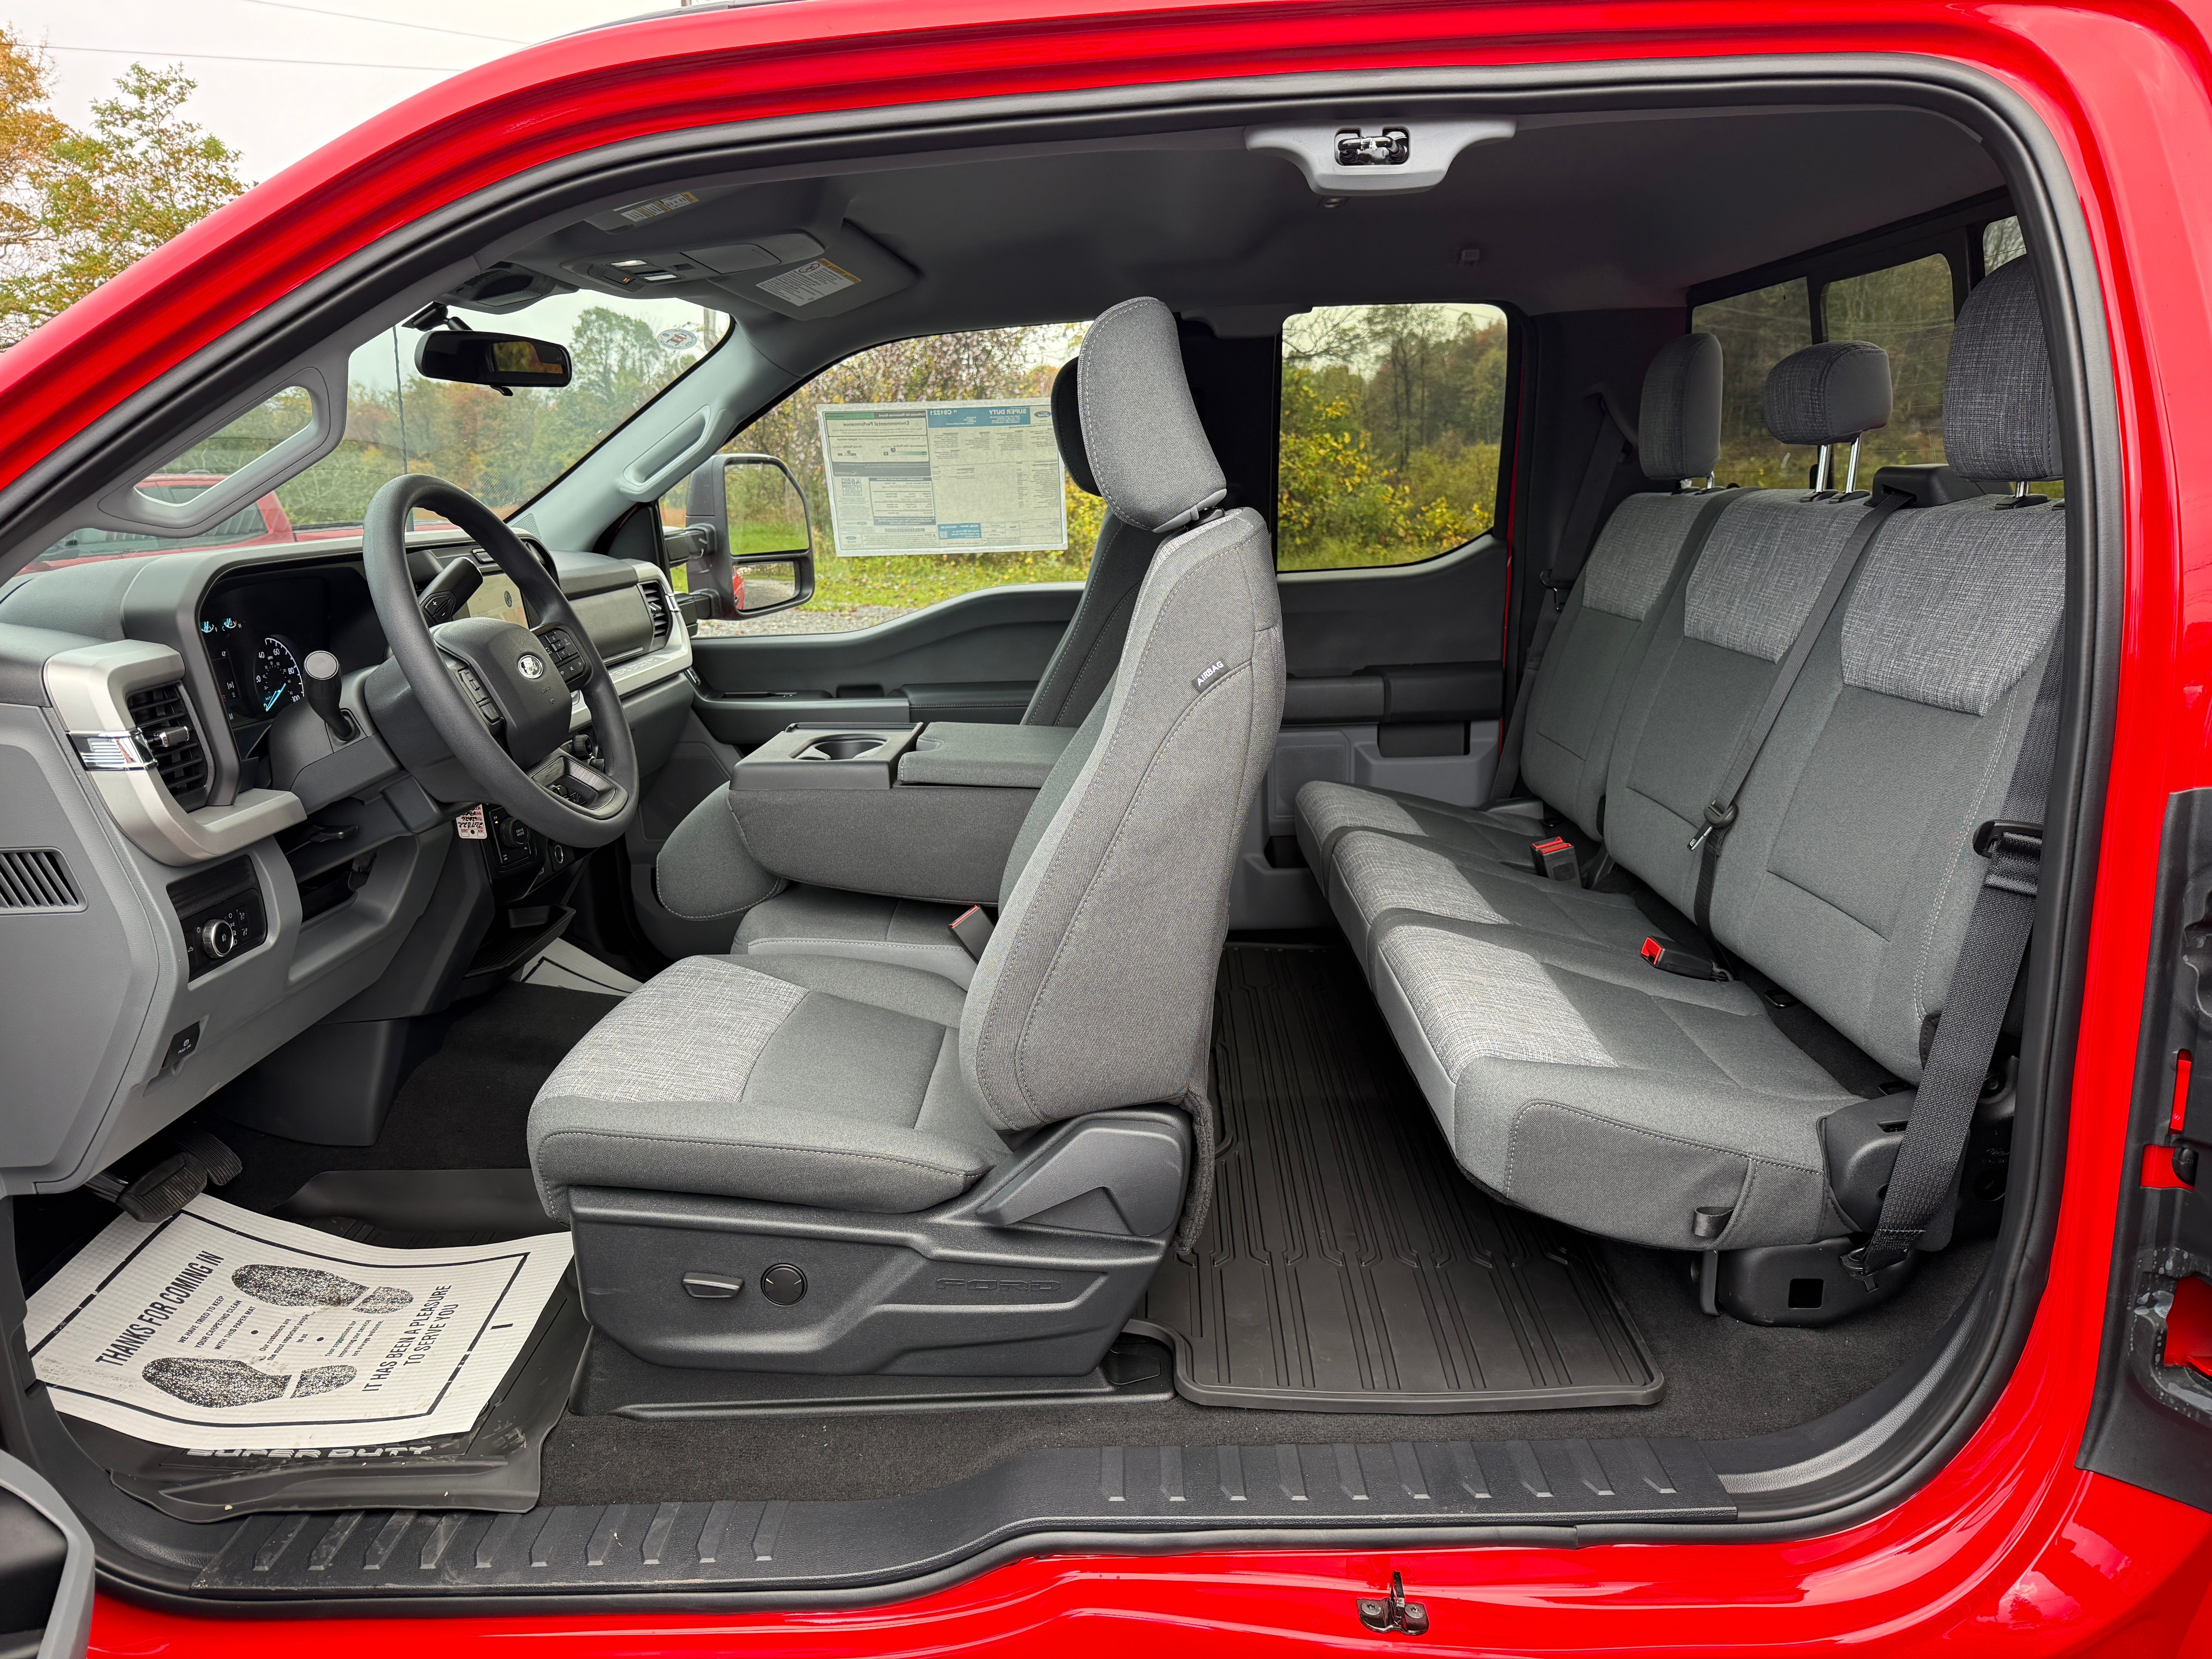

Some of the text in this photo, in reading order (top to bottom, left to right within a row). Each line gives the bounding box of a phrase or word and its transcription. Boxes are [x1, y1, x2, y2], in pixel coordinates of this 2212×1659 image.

[1197, 661, 1224, 686] AIRBAG
[936, 1278, 1061, 1291] FORD
[95, 1250, 224, 1366] THANKS FOR COMING IN
[184, 1324, 199, 1336] HAVE
[195, 1312, 210, 1324] TRIED
[212, 1295, 224, 1306] KEEP
[409, 1285, 452, 1327] PLEASURE
[194, 1300, 242, 1348] YOUR CARPETING CLEAN
[214, 1306, 256, 1350] WITH THIS PAPER MAT
[267, 1325, 286, 1344] customers
[274, 1344, 285, 1353] most
[282, 1326, 300, 1343] important
[297, 1314, 310, 1326] people
[403, 1304, 459, 1366] TO SERVE YOU
[385, 1337, 416, 1358] BEEN
[369, 1361, 397, 1380] HAS
[362, 1383, 383, 1391] IT
[186, 1446, 432, 1458] SUPER DUTY
